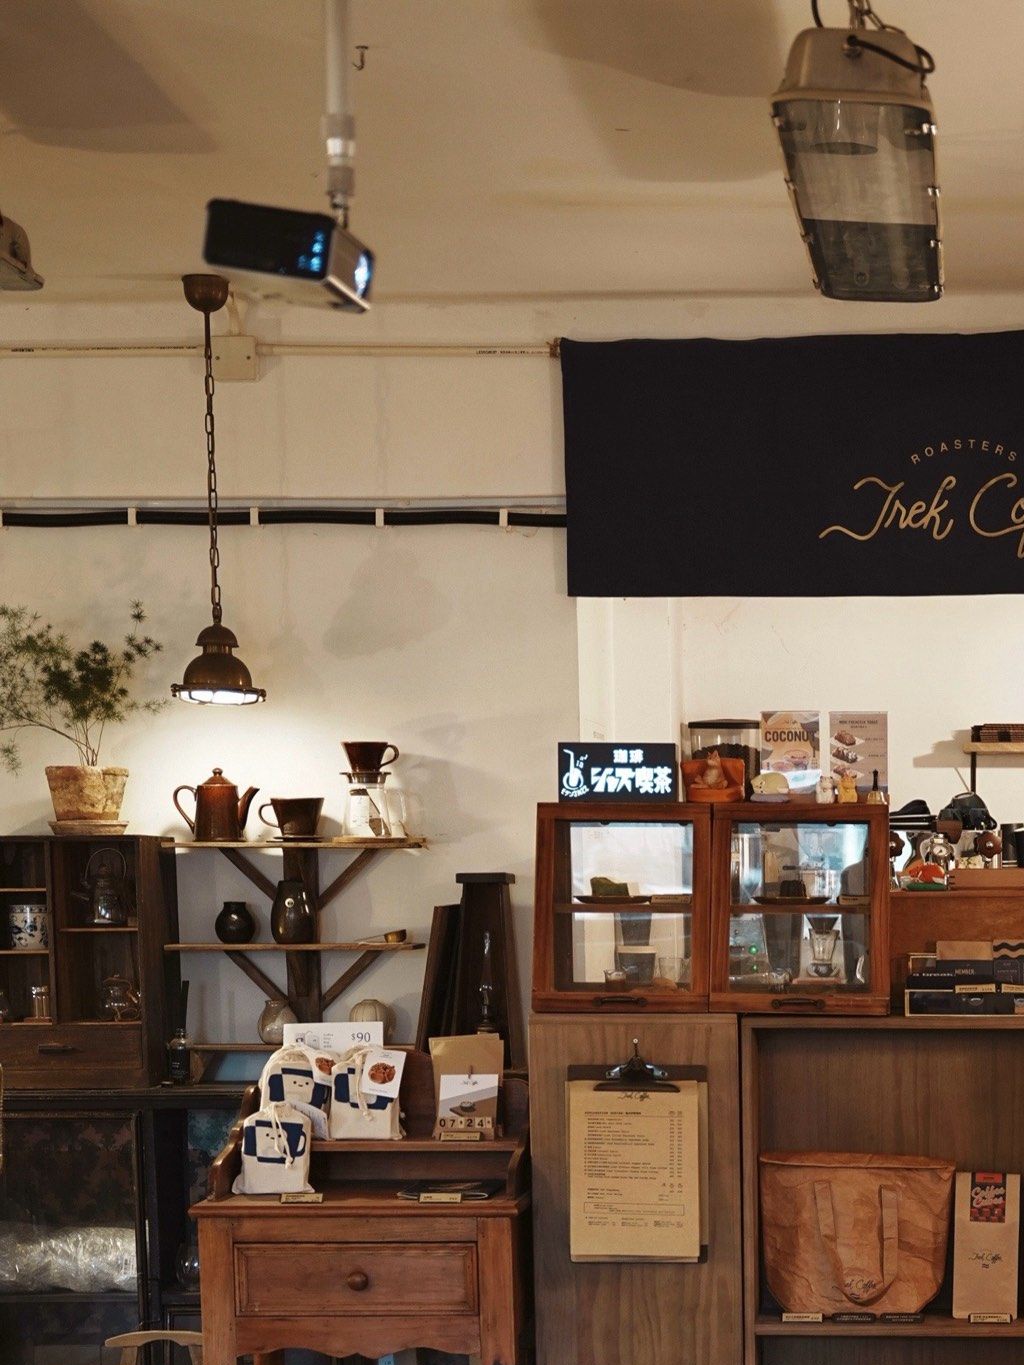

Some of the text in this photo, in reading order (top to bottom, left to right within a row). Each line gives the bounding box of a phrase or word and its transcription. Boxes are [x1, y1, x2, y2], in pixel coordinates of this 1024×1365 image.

[910, 438, 1018, 464] ROASTERS
[819, 475, 957, 541] Trek
[613, 748, 644, 764] 珈琲
[590, 766, 673, 794] ジャズ喫茶
[351, 1032, 371, 1043] $90
